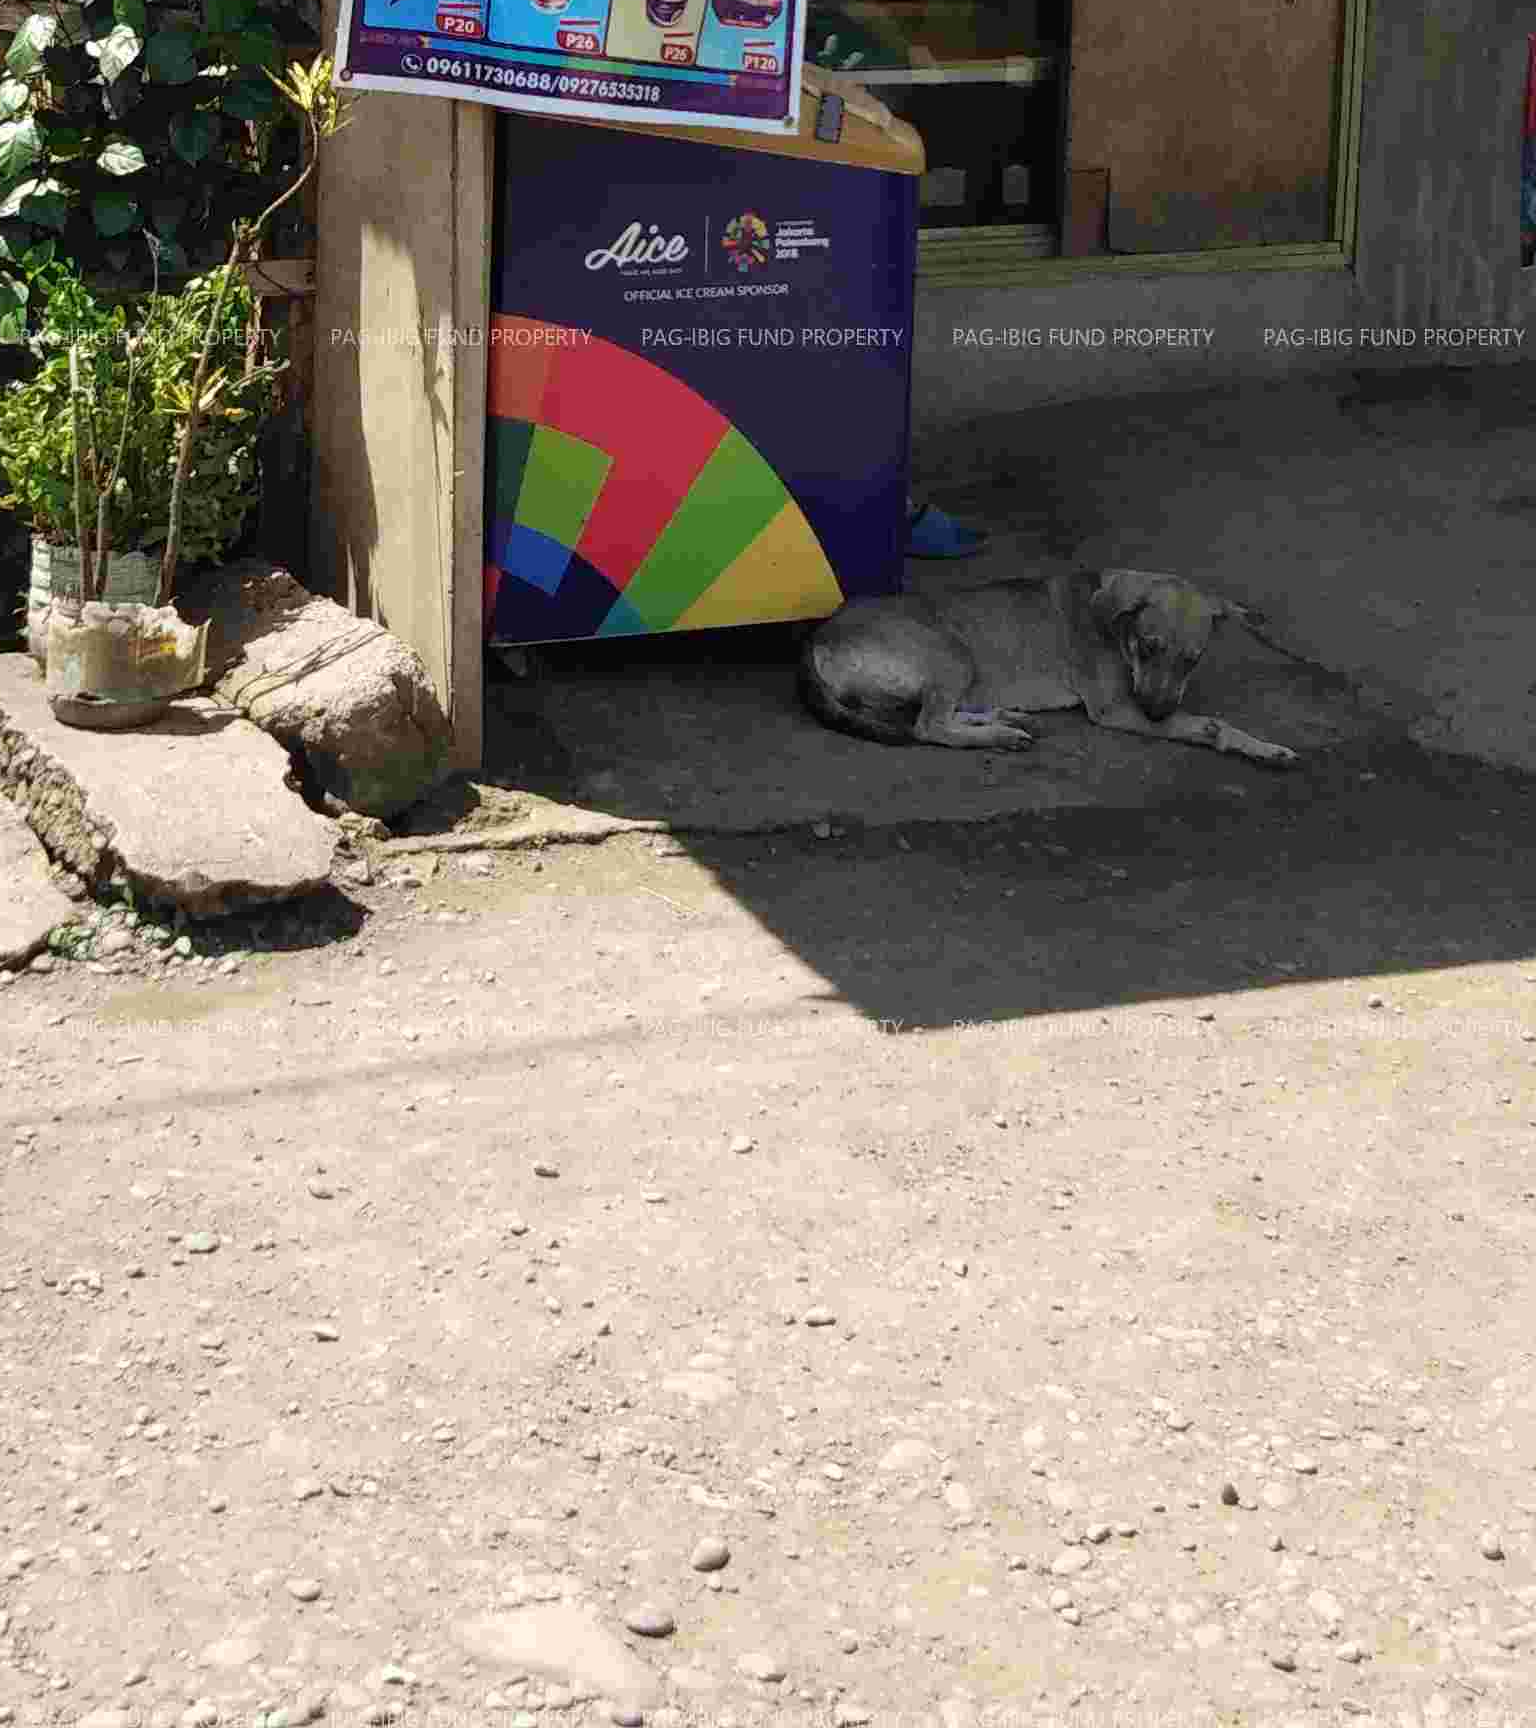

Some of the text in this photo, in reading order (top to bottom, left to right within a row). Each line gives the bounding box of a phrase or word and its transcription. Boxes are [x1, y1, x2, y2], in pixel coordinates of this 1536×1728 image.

[444, 17, 474, 33] P20
[565, 33, 594, 49] P26
[744, 56, 776, 72] P120
[584, 221, 689, 271] Aice
[623, 283, 789, 302] OFFICIAL ICE CREAM SPONSOR
